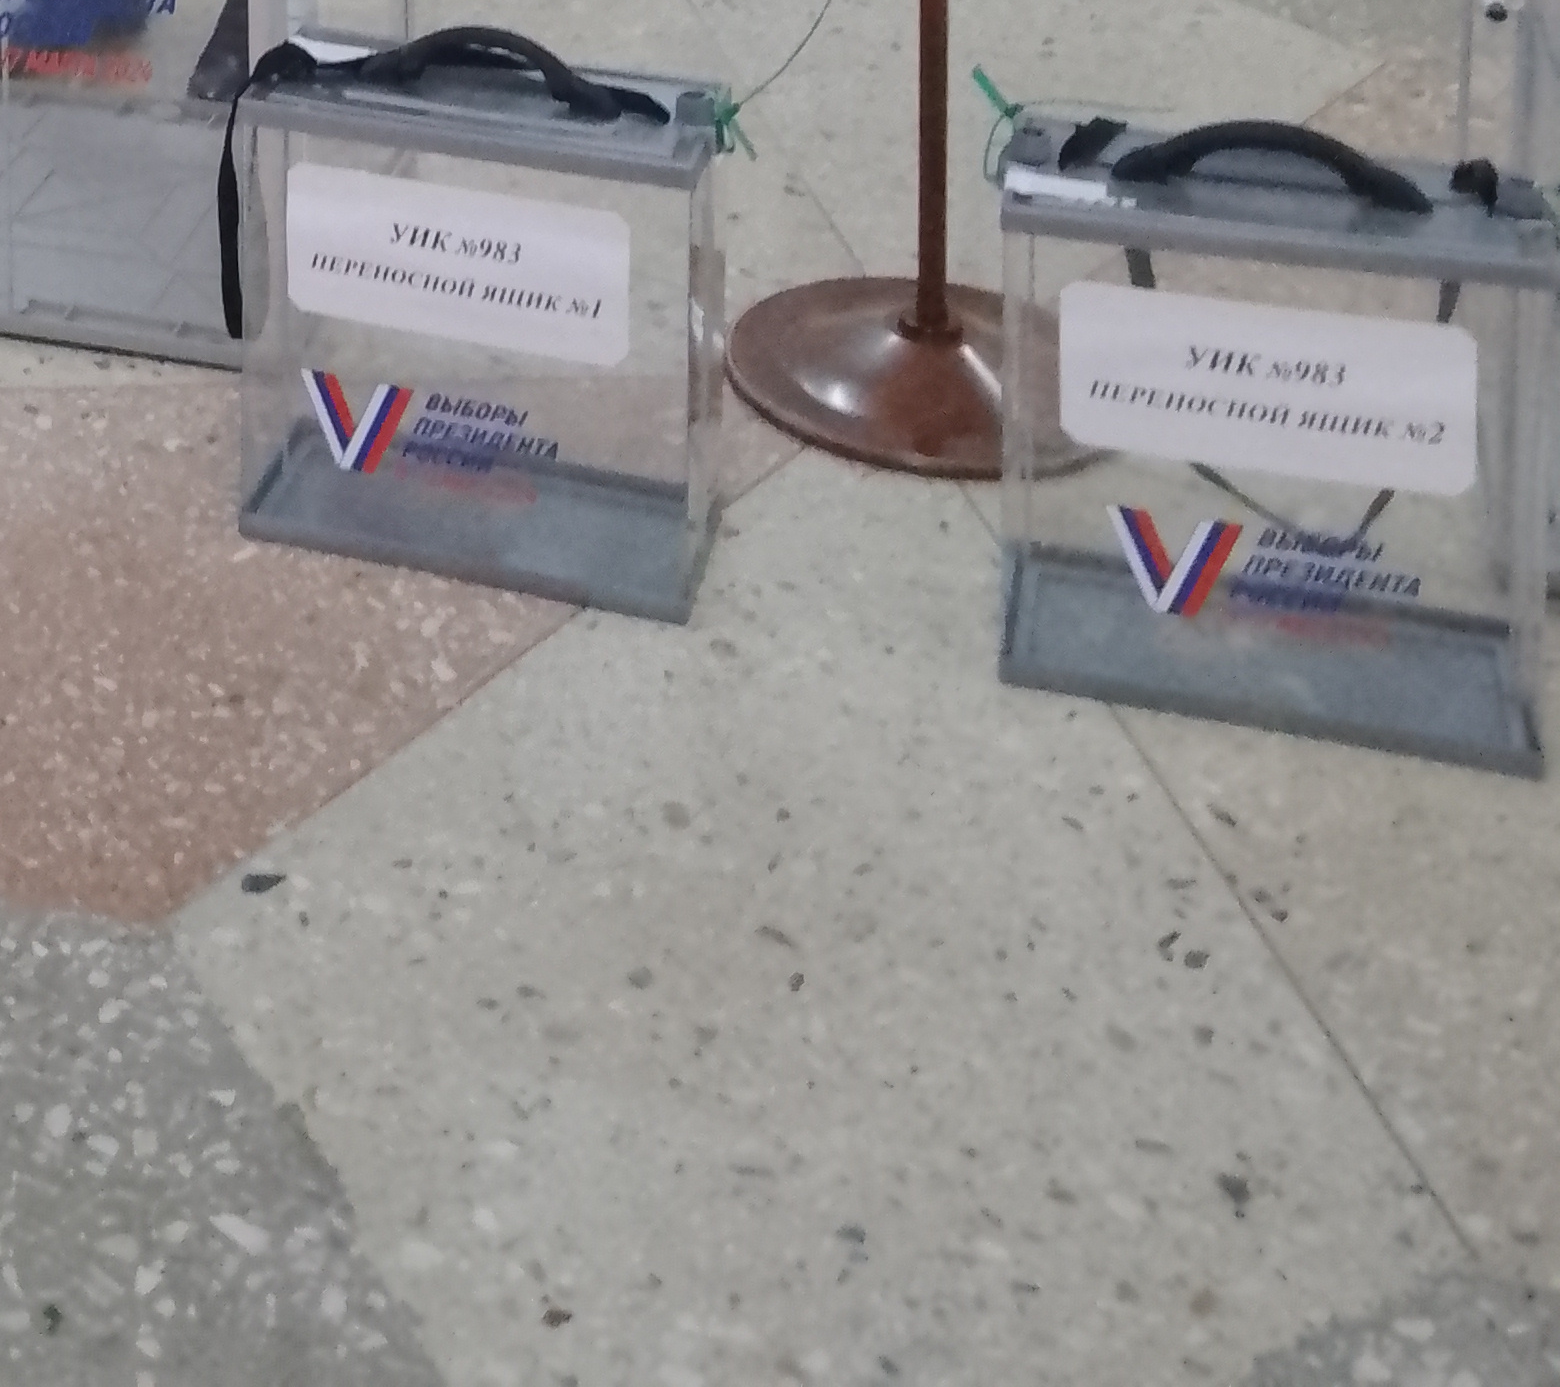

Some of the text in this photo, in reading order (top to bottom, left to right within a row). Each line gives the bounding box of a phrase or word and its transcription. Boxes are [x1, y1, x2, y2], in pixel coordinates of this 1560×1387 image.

[390, 223, 452, 253] УИК
[311, 252, 475, 298] ПЕРЕНОСНОЙ
[480, 283, 561, 313] ЯЩИК
[1187, 344, 1261, 377] УИК
[425, 392, 529, 428] ВЫБОРЫ
